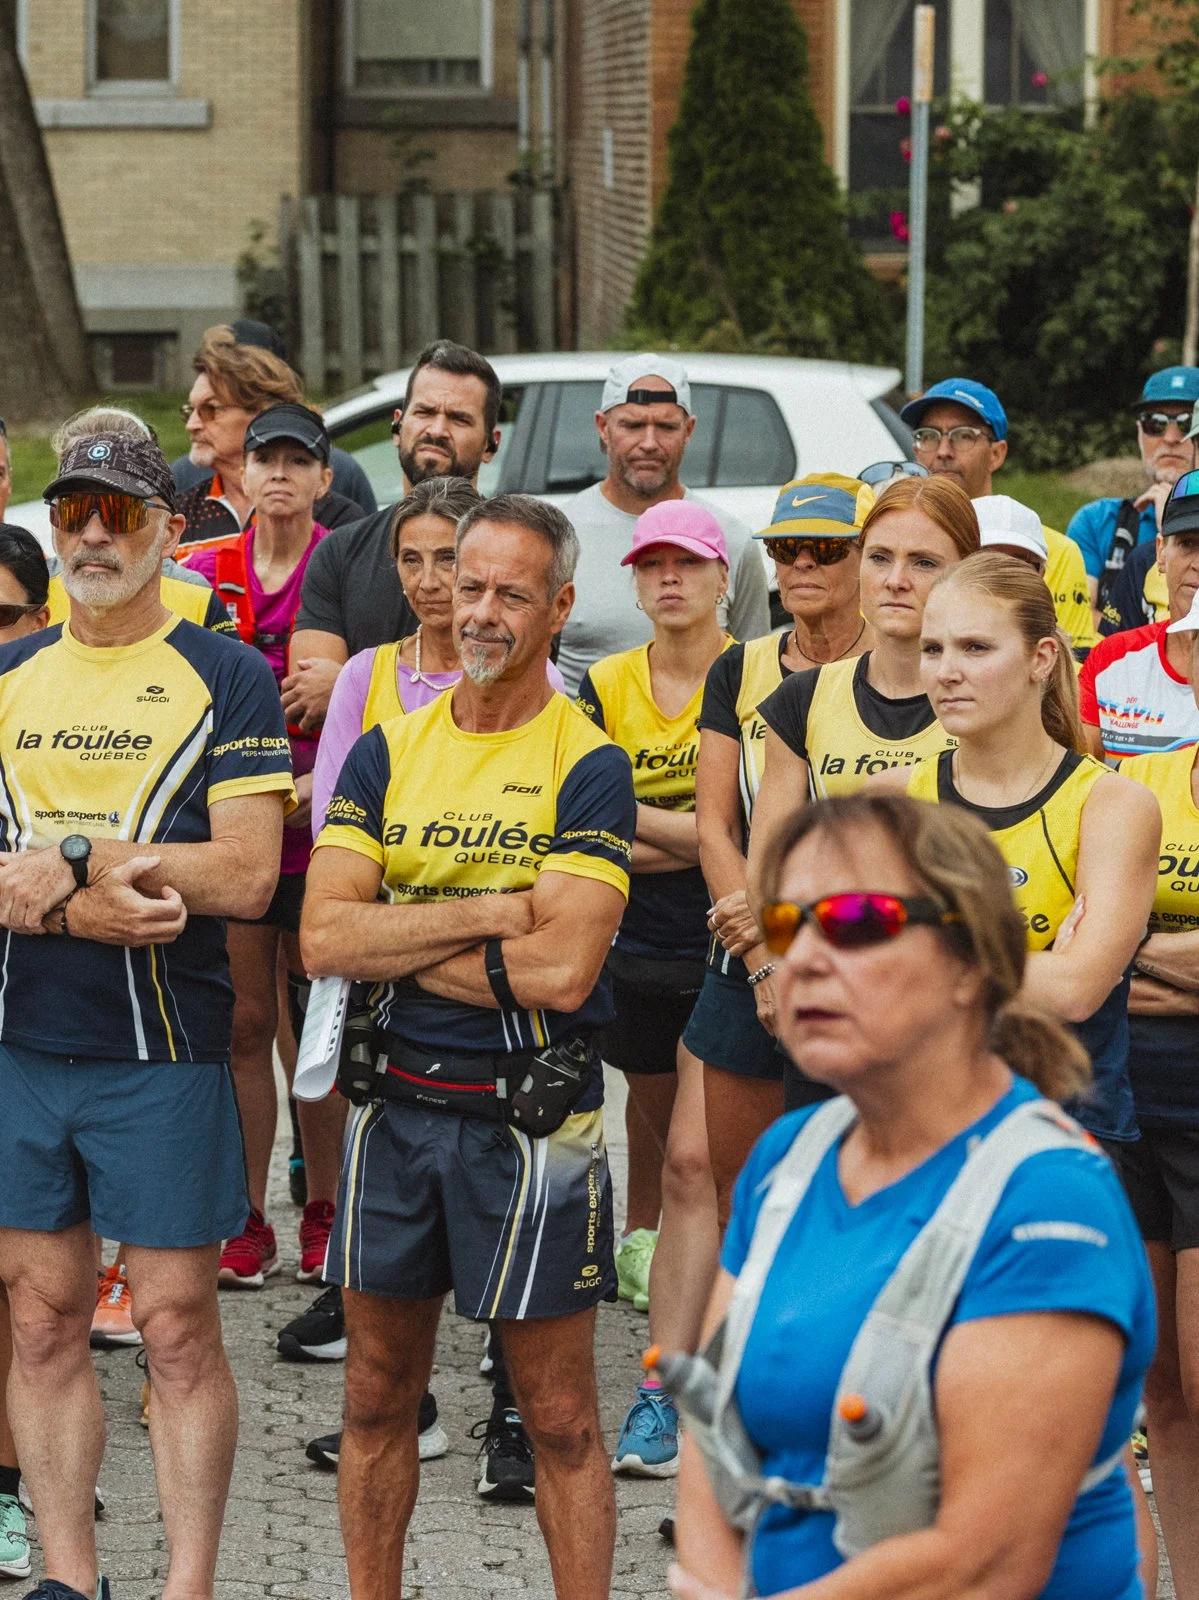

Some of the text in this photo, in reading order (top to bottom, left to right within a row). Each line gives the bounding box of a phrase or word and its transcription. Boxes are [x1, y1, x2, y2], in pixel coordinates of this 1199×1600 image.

[15, 729, 153, 750] la foulée
[213, 736, 260, 756] sports
[79, 751, 147, 761] QUÉBEC
[875, 750, 915, 758] CLUB
[820, 754, 846, 775] la
[35, 809, 107, 821] sports experts
[443, 812, 493, 822] CLUB
[420, 820, 557, 856] foulée
[561, 830, 598, 840] sports
[398, 882, 439, 897] sports
[586, 1211, 597, 1254] sports
